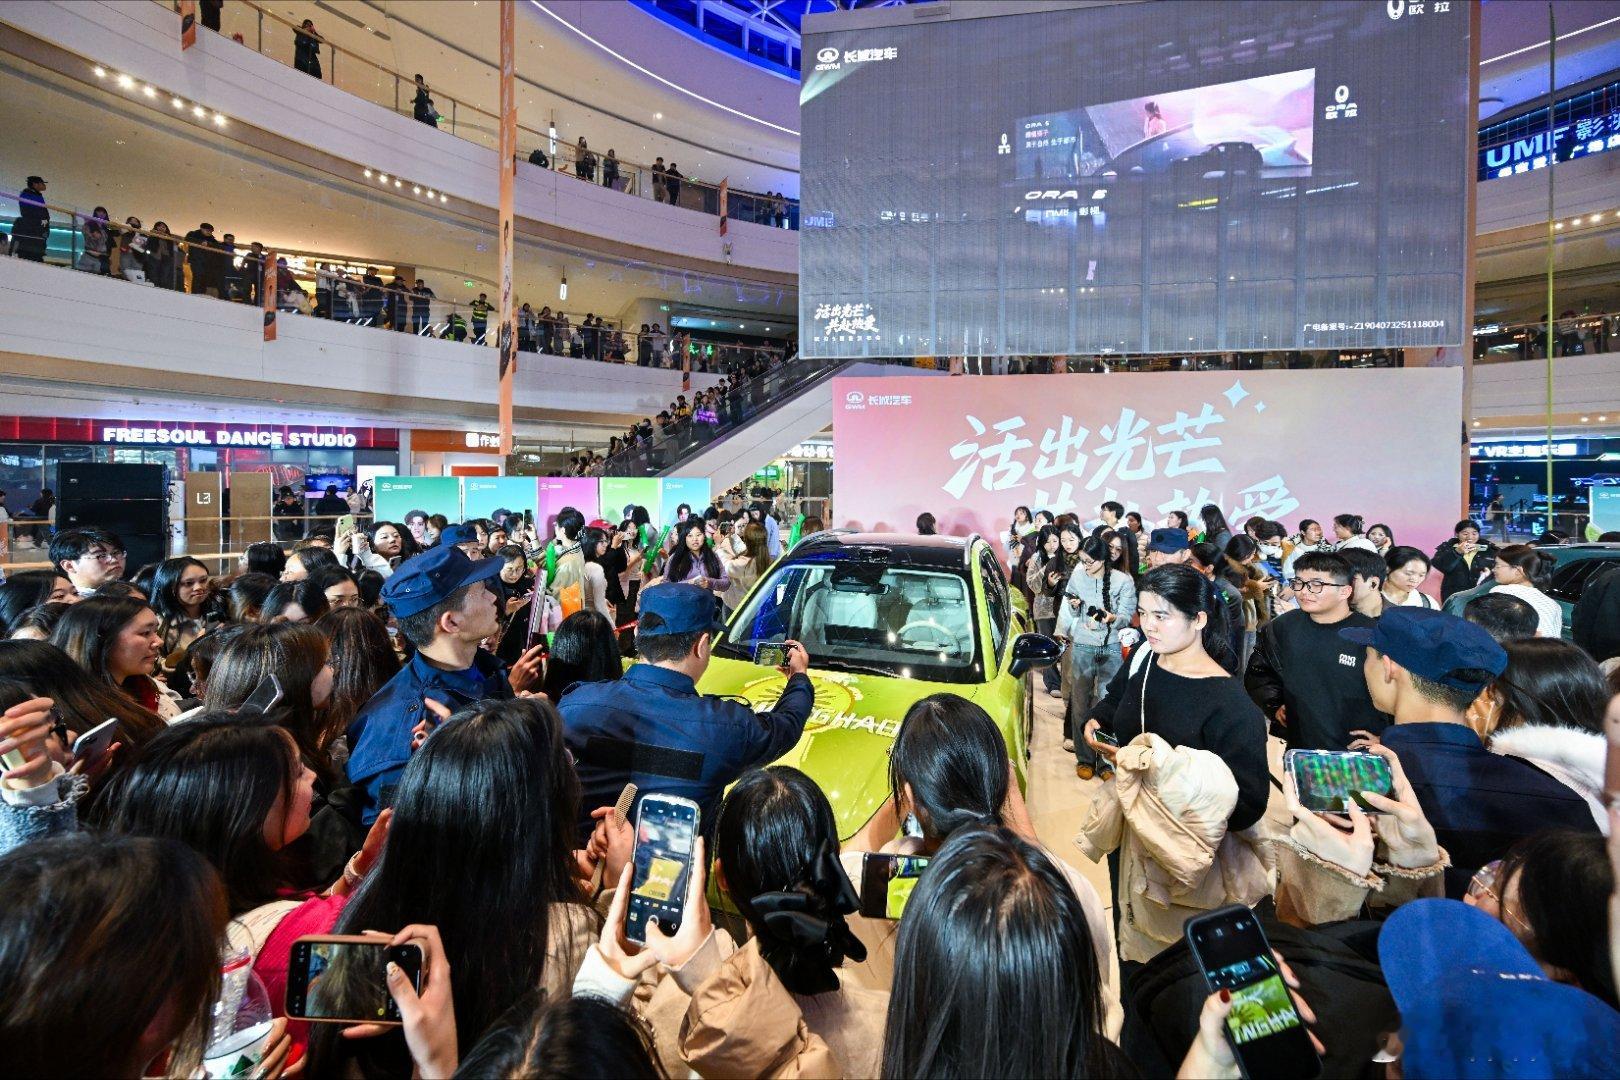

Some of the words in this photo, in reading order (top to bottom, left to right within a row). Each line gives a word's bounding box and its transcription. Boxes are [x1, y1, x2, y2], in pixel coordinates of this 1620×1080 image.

[1025, 190, 1078, 200] ORA
[103, 428, 211, 444] FREESOUL
[216, 431, 285, 446] DANCE
[288, 433, 357, 447] STUDIO
[942, 402, 1226, 500] 活出光芒
